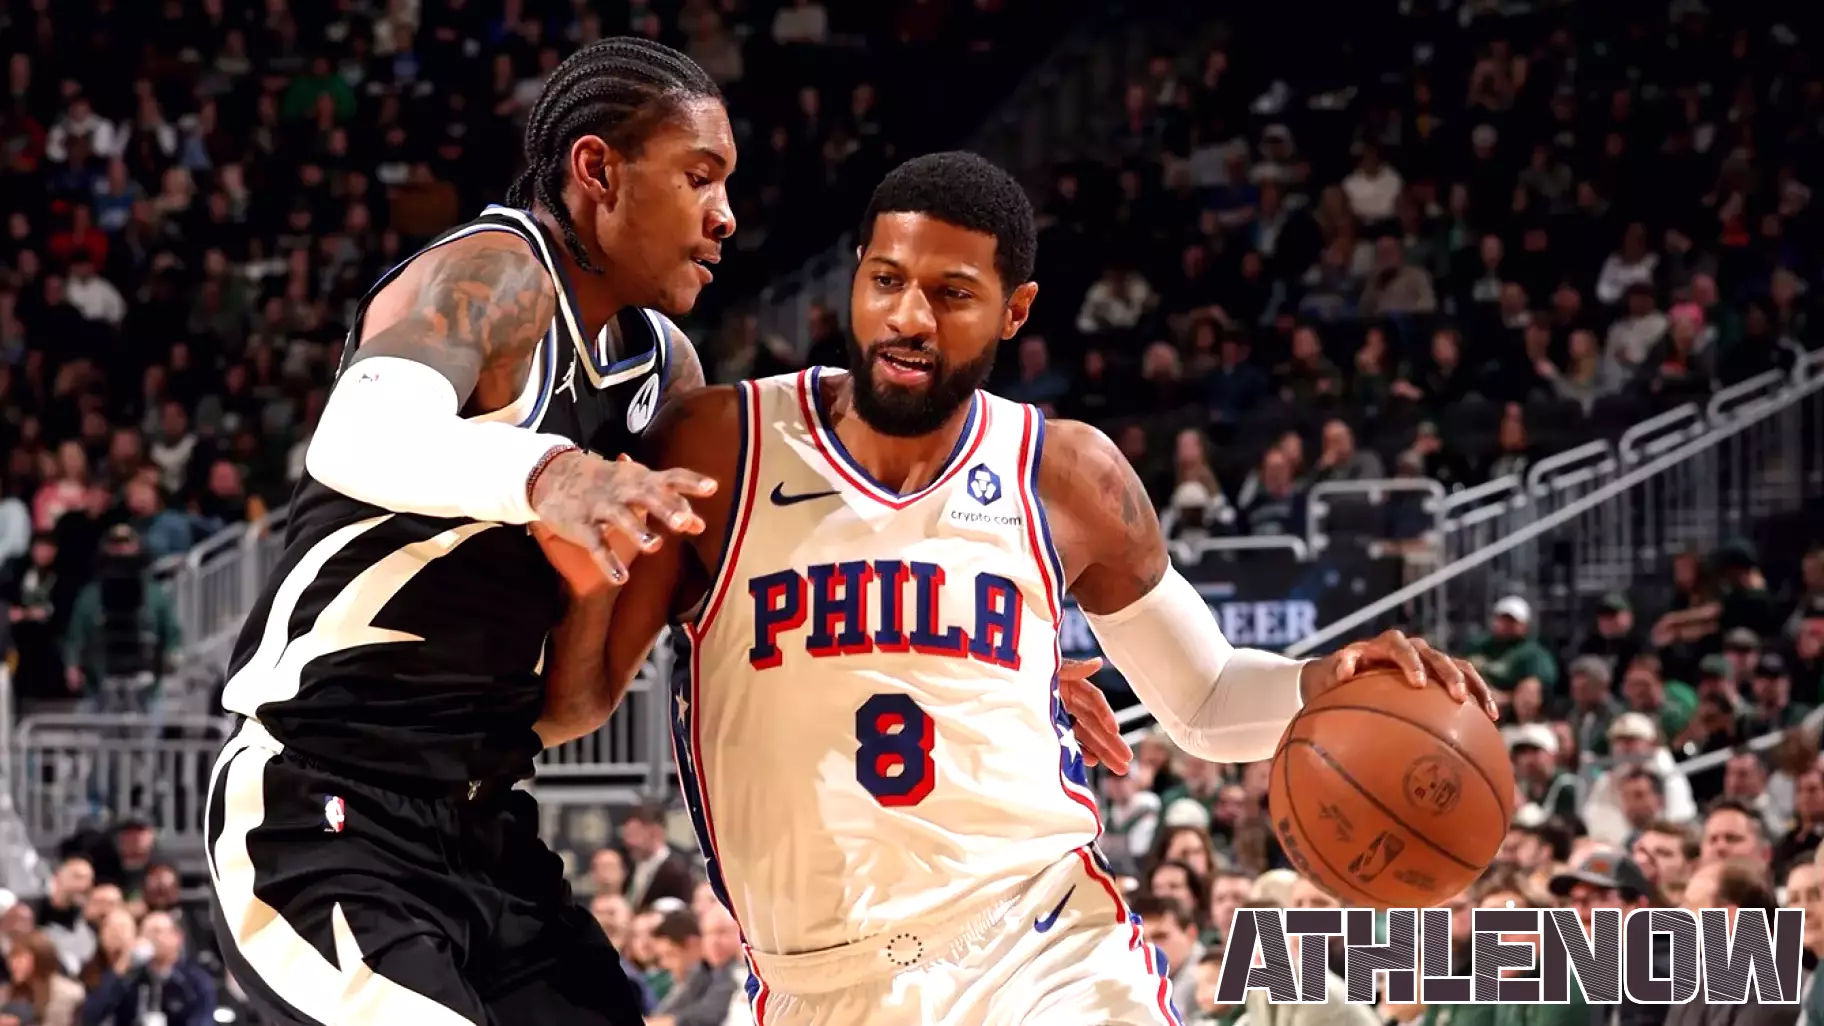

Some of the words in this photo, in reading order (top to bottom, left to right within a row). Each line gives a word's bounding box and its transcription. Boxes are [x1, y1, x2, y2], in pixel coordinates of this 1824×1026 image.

[950, 510, 1022, 526] cryptocom
[748, 560, 1023, 671] PHILA
[1214, 601, 1319, 644] EER
[855, 693, 935, 807] 8
